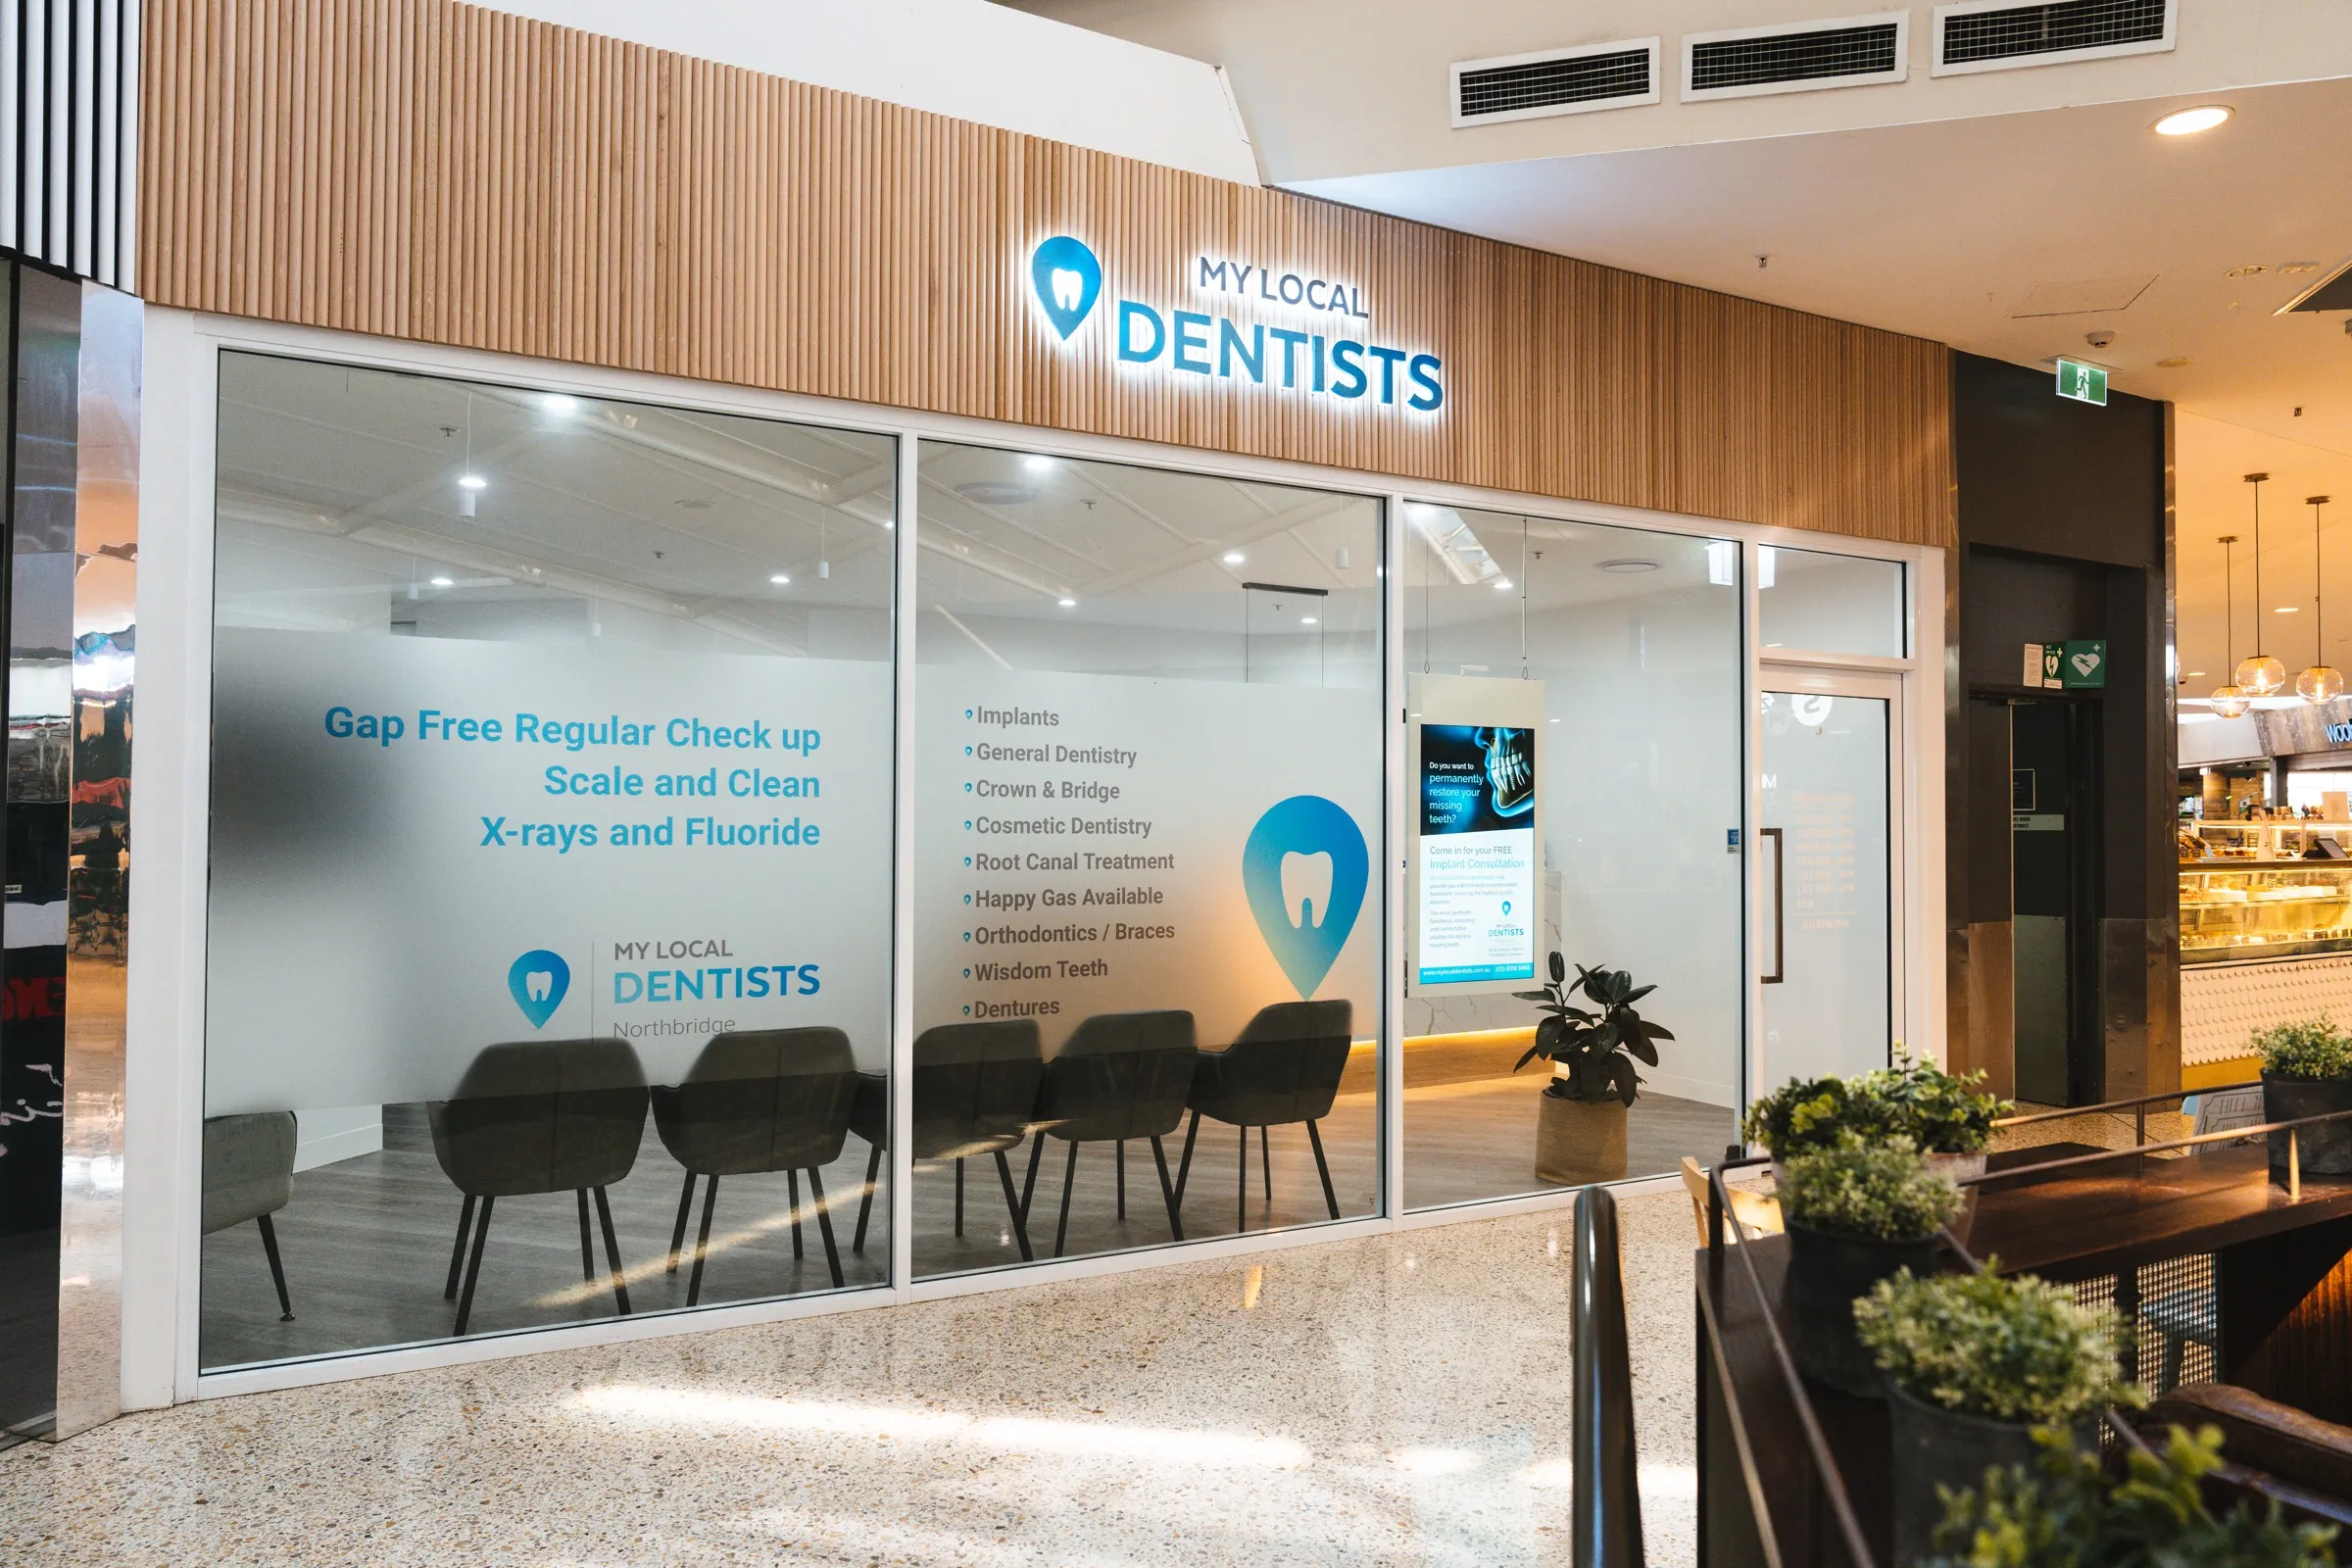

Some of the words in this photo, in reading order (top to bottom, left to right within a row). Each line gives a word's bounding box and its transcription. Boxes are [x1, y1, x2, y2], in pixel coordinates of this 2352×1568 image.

[1200, 256, 1252, 294] MY
[1261, 269, 1368, 318] LOCAL
[1117, 299, 1444, 412] DENTISTS
[977, 706, 1059, 727] Implants
[324, 706, 405, 747] Gap
[418, 710, 503, 742] Free
[515, 712, 656, 752] Regular
[666, 717, 771, 750] Check
[782, 727, 821, 763] up
[977, 743, 1050, 762] General
[1055, 745, 1137, 768] Dentistry
[544, 765, 644, 796] Scale
[655, 767, 716, 797] and
[728, 769, 820, 799] Clean
[1430, 774, 1484, 785] permanently
[976, 780, 1037, 799] Crown
[1042, 781, 1055, 799] &
[1061, 781, 1120, 803] Bridge
[1430, 788, 1459, 797] restore
[1430, 801, 1461, 811] missing
[976, 815, 1065, 835] Cosmetic
[1071, 817, 1152, 839] Dentistry
[1430, 814, 1456, 823] teeth?
[479, 815, 598, 854] X-rays
[610, 815, 673, 846] and
[685, 816, 820, 846] Fluoride
[976, 853, 1021, 871] Root
[1026, 852, 1078, 871] Canal
[1084, 852, 1175, 870] Treatment
[1463, 846, 1473, 855] for
[1430, 859, 1465, 870] Implant
[1468, 858, 1524, 868] Consultation
[975, 889, 1037, 912] Happy
[1042, 889, 1077, 907] Gas
[1082, 887, 1163, 906] Available
[975, 924, 1098, 945] Orthodontics
[1102, 923, 1110, 942] /
[1115, 922, 1175, 941] Braces
[1489, 928, 1524, 937] DENTISTS
[614, 942, 651, 960] MY
[657, 939, 733, 959] LOCAL
[975, 959, 1052, 982] Wisdom
[1056, 958, 1108, 978] Teeth
[613, 963, 820, 1004] DENTISTS
[975, 998, 1060, 1019] Dentures
[613, 1017, 736, 1038] Northbridge
